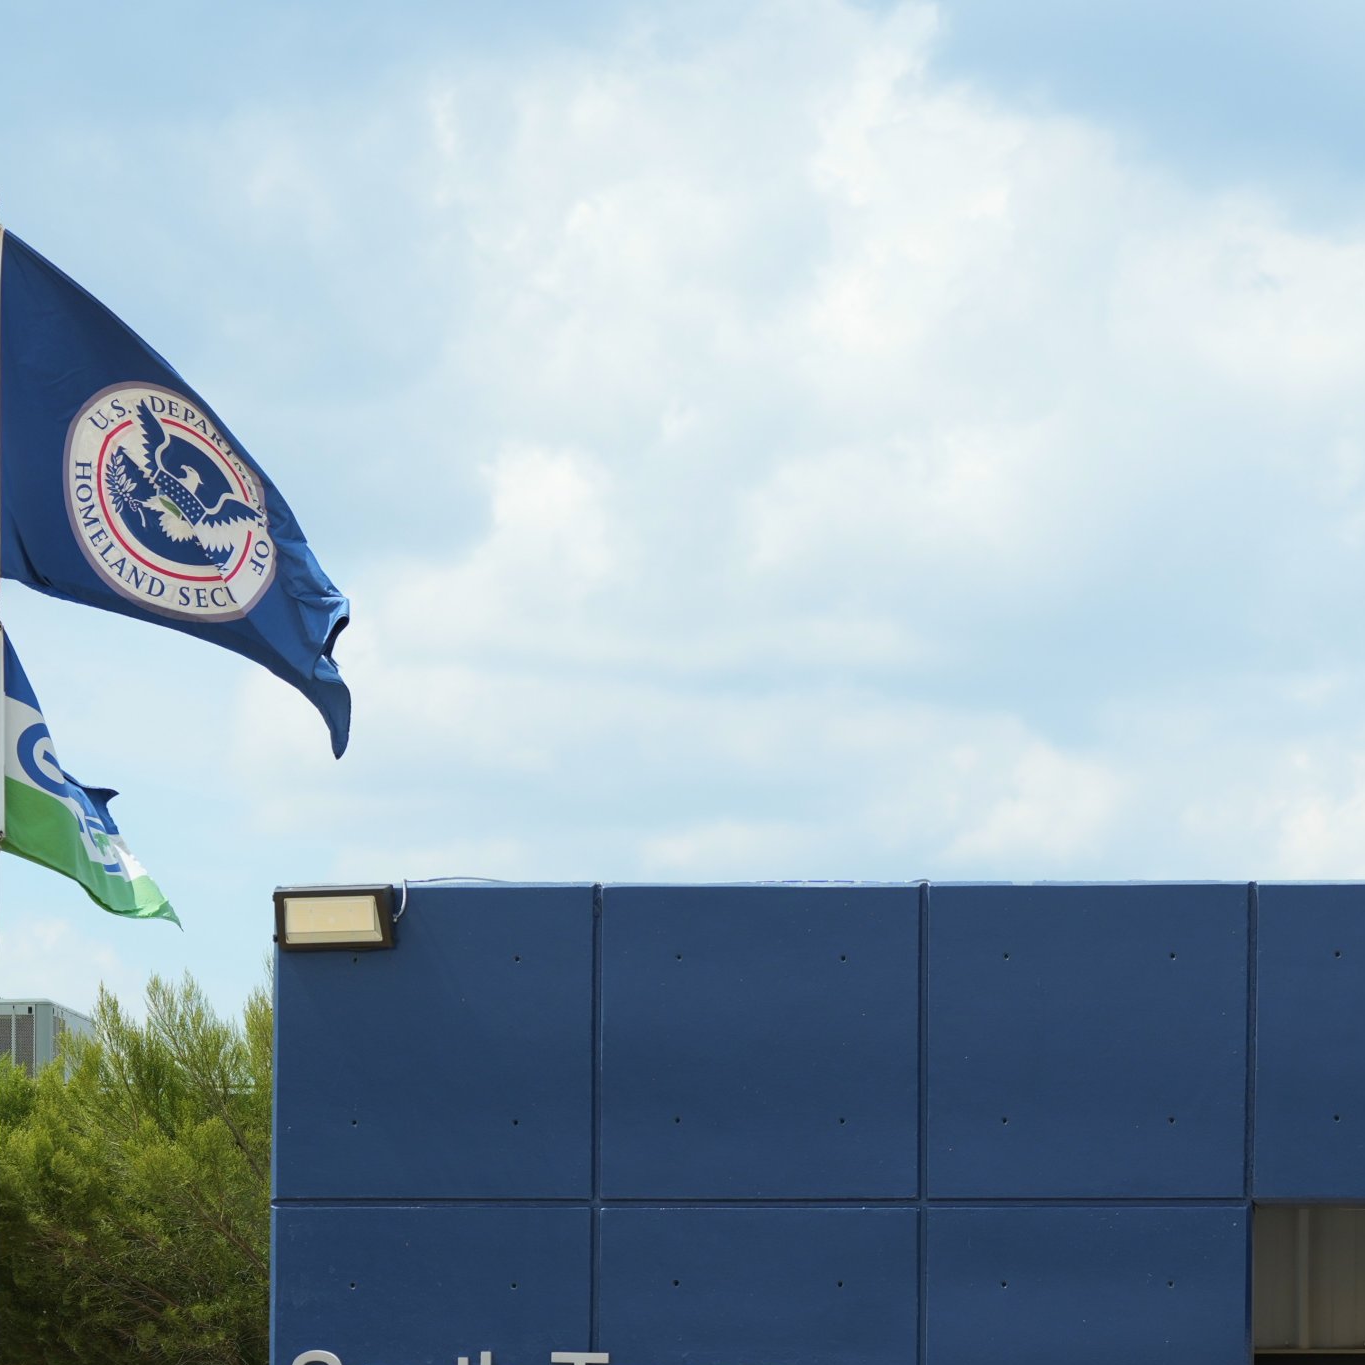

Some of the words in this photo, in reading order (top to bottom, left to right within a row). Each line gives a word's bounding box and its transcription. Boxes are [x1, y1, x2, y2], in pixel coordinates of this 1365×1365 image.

[74, 461, 166, 598] HOMELAND
[87, 397, 132, 431] U.S.
[248, 540, 271, 578] OF
